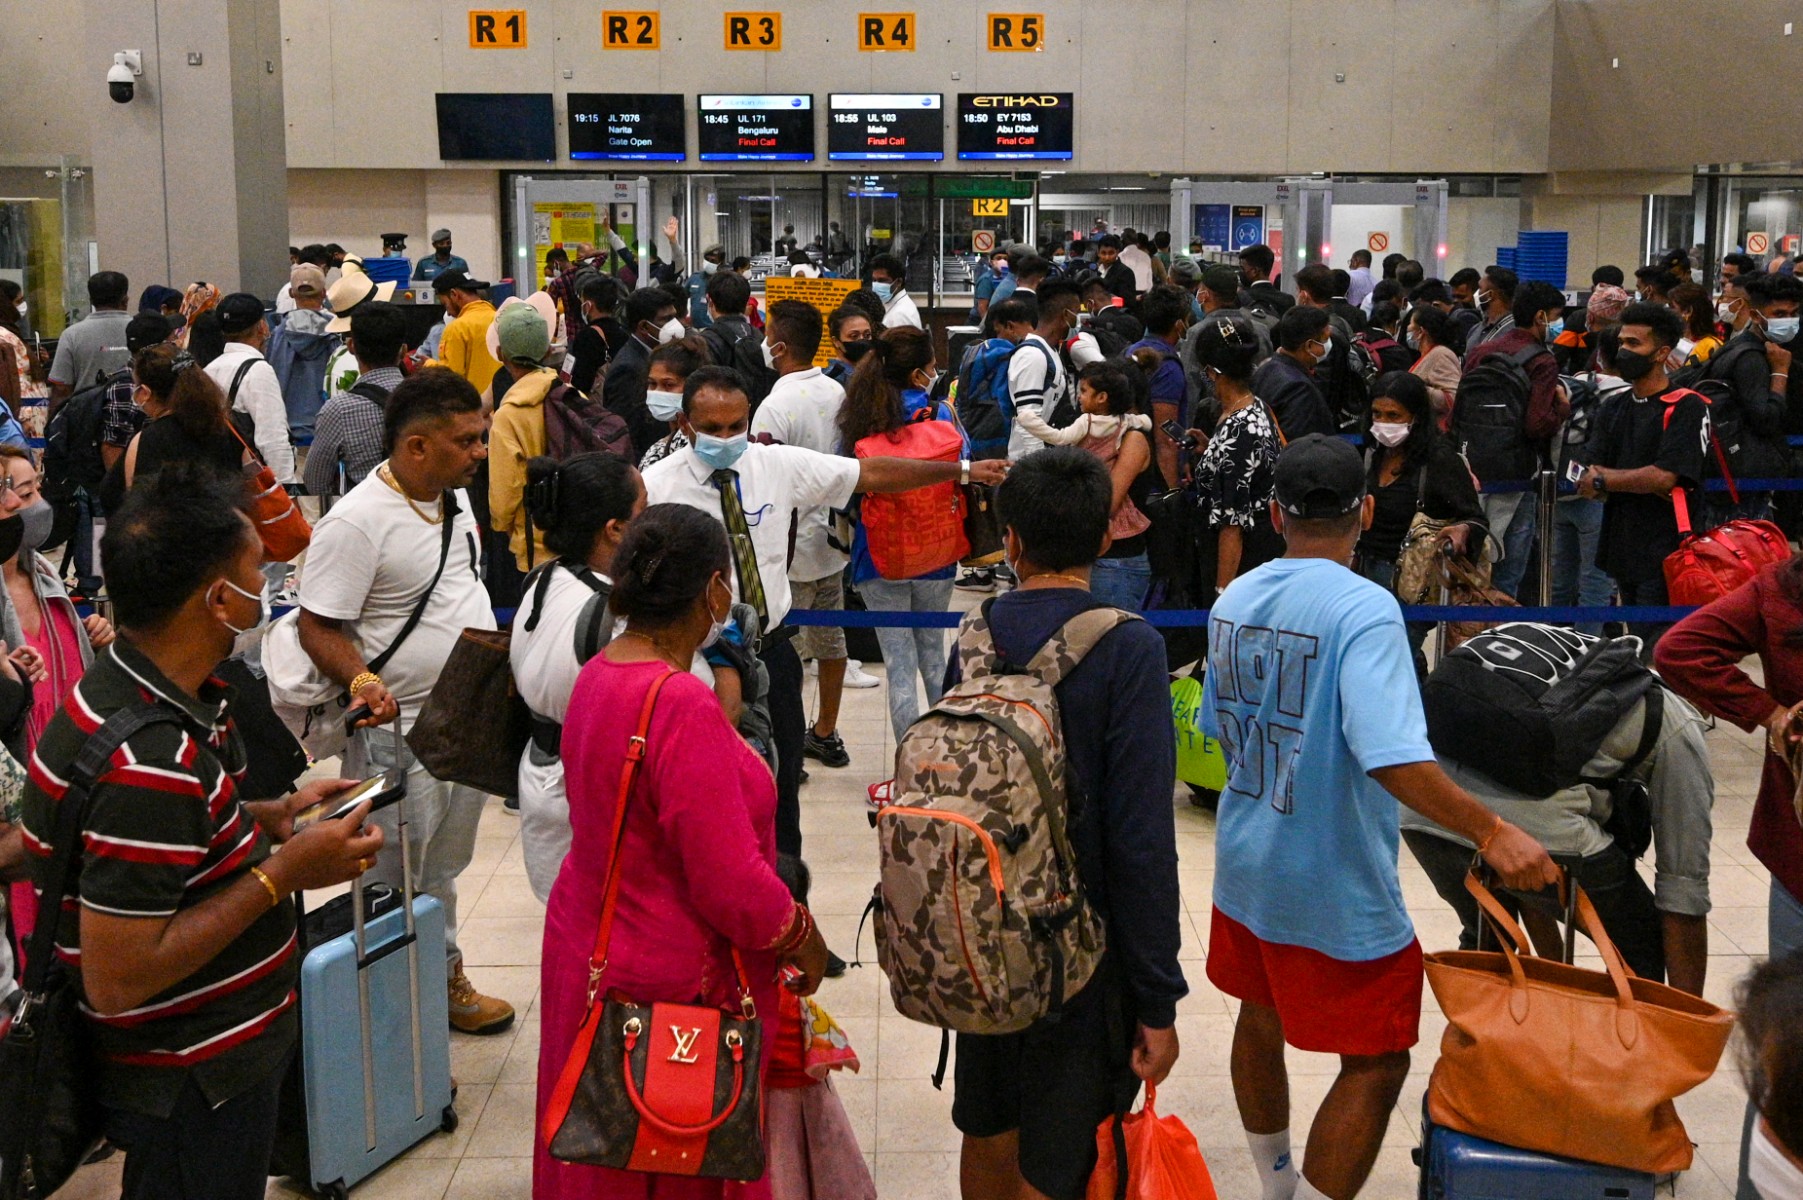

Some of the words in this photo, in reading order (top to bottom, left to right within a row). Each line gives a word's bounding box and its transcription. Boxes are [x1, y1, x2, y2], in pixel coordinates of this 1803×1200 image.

[972, 95, 1059, 107] ETIHAD
[574, 114, 599, 122] 19:15
[607, 114, 618, 122] JL
[619, 114, 641, 122] 7076
[704, 115, 729, 124] 18:45
[737, 115, 749, 123] UL
[752, 115, 766, 123] 171
[834, 114, 859, 123] 18:55
[867, 114, 879, 122] UL
[881, 114, 897, 122] 103
[963, 114, 989, 123] 18:50
[996, 113, 1010, 122] EY
[1011, 113, 1032, 122] 7153
[608, 125, 633, 134] Narita
[737, 126, 779, 136] Bengaluru
[867, 125, 888, 134] Male
[996, 125, 1014, 133] Abu
[1014, 125, 1039, 133] Dhabi
[608, 137, 629, 146] Gate
[630, 137, 653, 147] Open
[738, 138, 758, 146] Final
[760, 138, 776, 146] Call
[867, 137, 888, 145] Final
[889, 137, 905, 145] Call
[996, 137, 1017, 145] Final
[1018, 137, 1035, 145] Call
